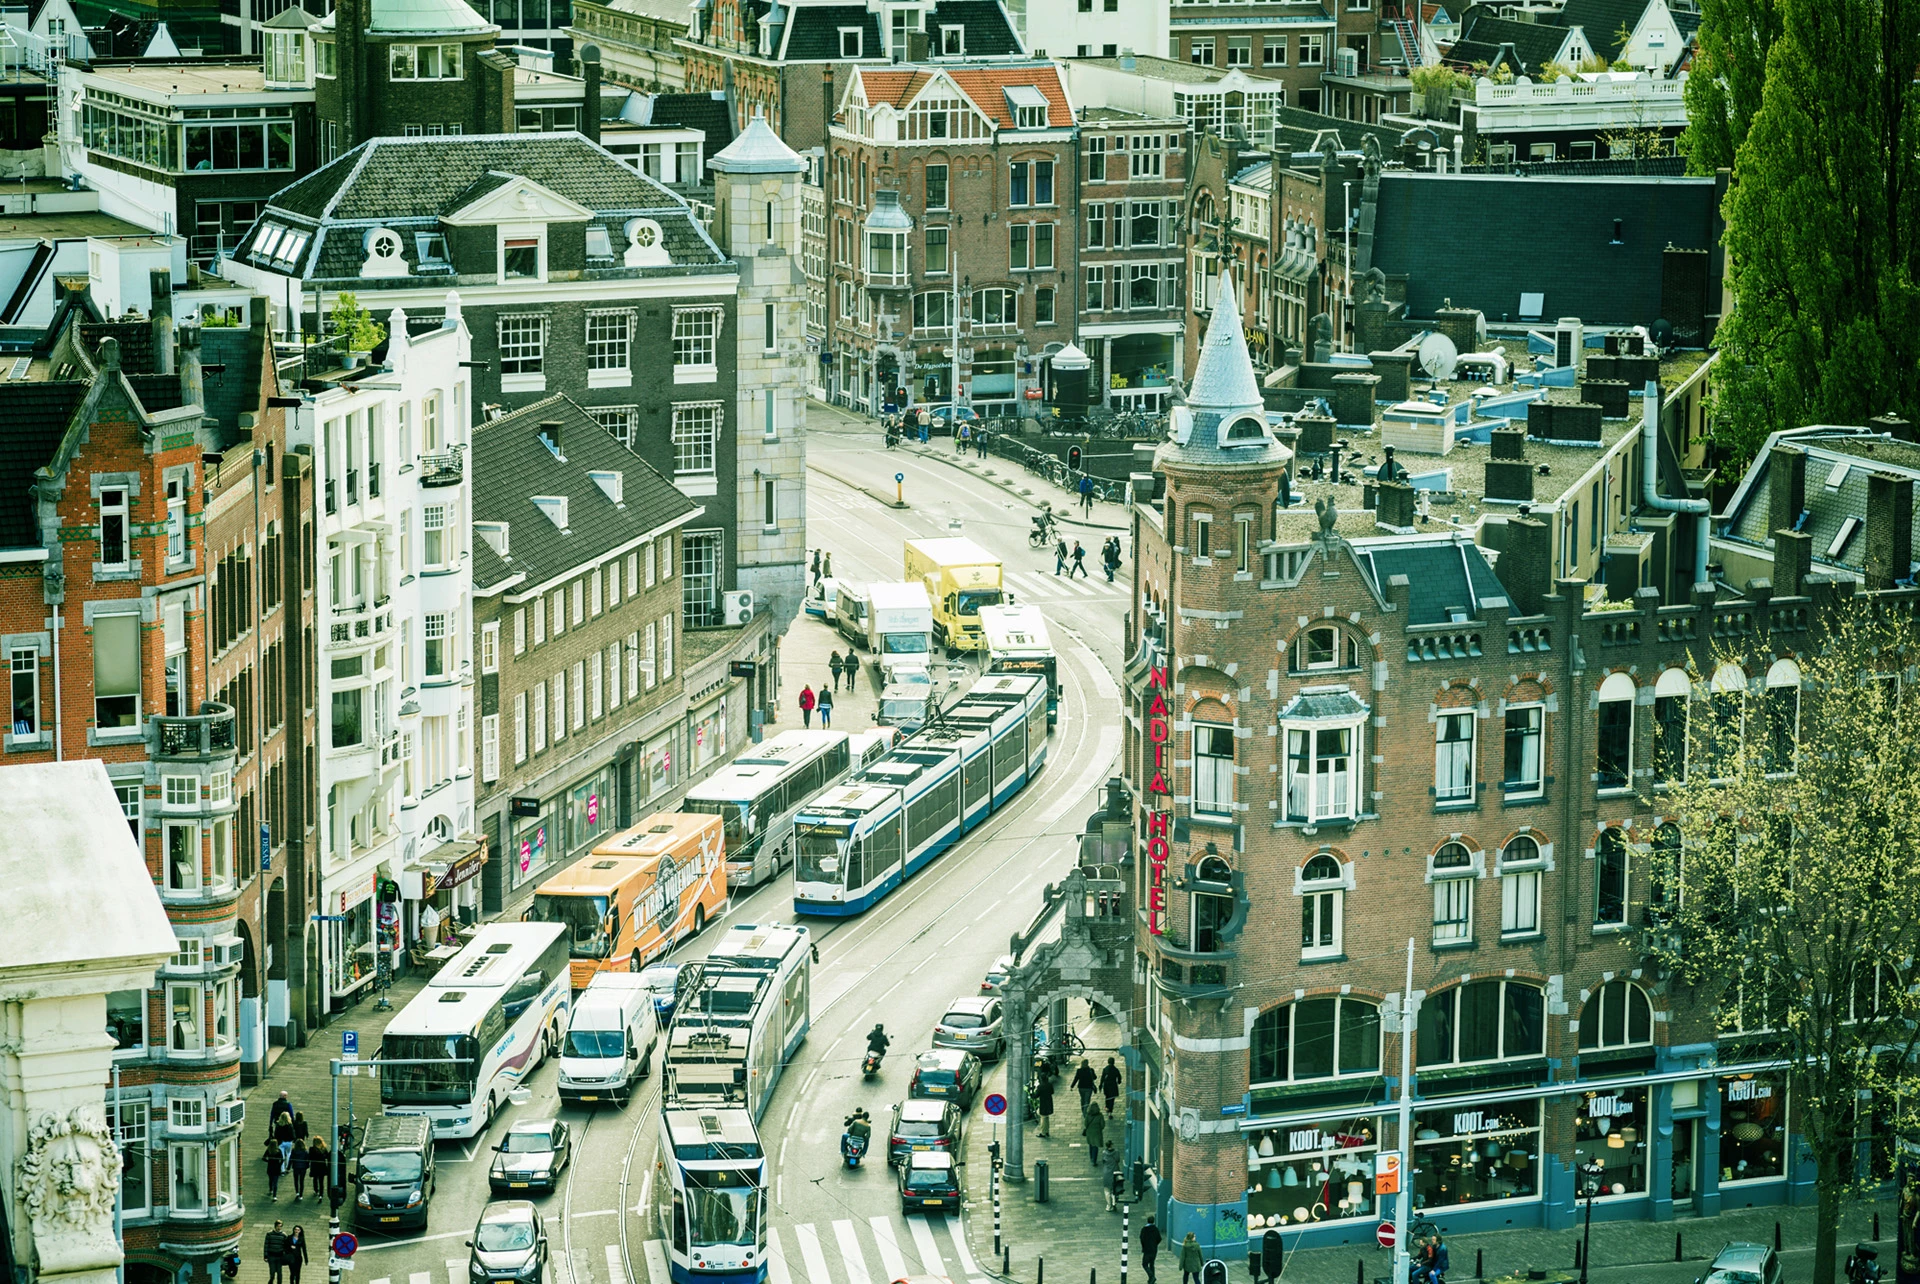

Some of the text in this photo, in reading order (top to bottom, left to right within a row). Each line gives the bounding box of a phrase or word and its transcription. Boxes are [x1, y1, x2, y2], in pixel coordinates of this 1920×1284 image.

[1149, 664, 1168, 795] NADIA
[454, 860, 480, 883] Jennifer
[645, 885, 664, 923] KRAS
[664, 853, 702, 904] VOLENDAM
[1147, 811, 1169, 935] HOTEL
[346, 1034, 354, 1044] P
[718, 1172, 726, 1181] 14
